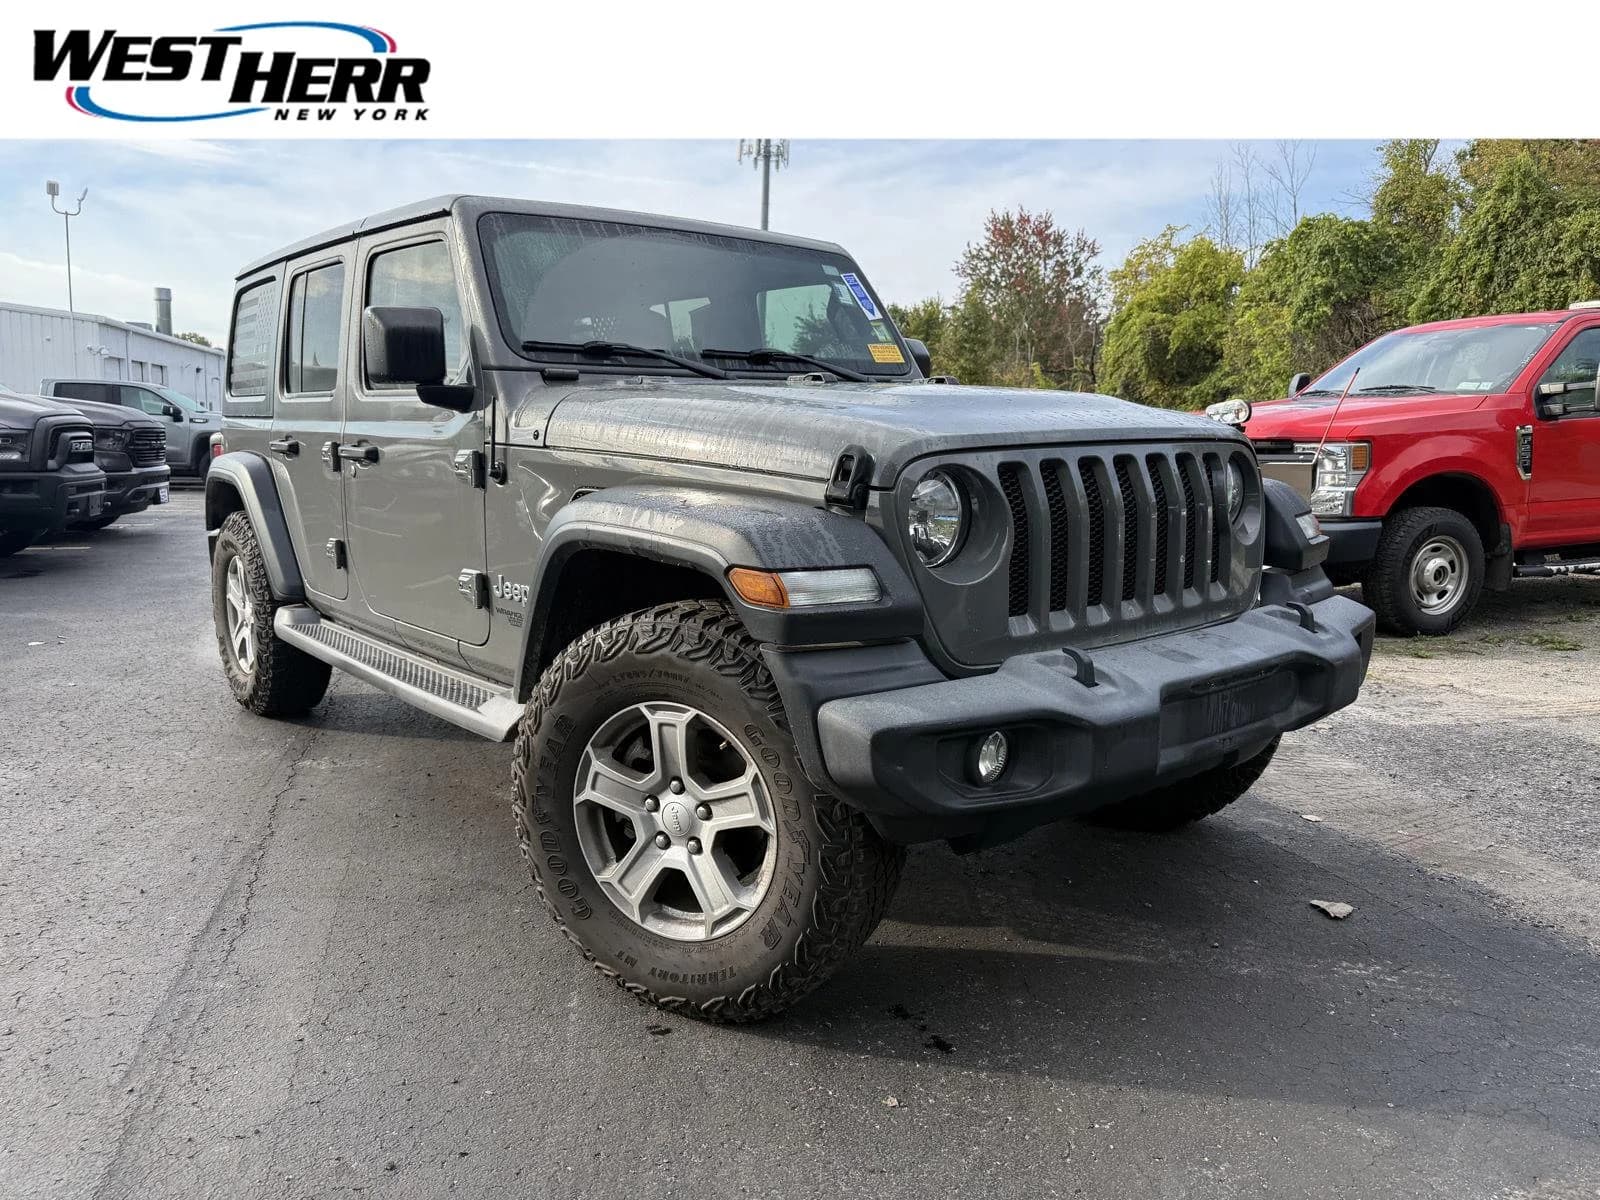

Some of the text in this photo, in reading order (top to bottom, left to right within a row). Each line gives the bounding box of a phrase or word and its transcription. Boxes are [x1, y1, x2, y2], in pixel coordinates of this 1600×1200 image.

[493, 574, 529, 607] Jeep
[744, 723, 811, 950] GOODYEAR
[614, 949, 738, 986] TERRITORY MT
